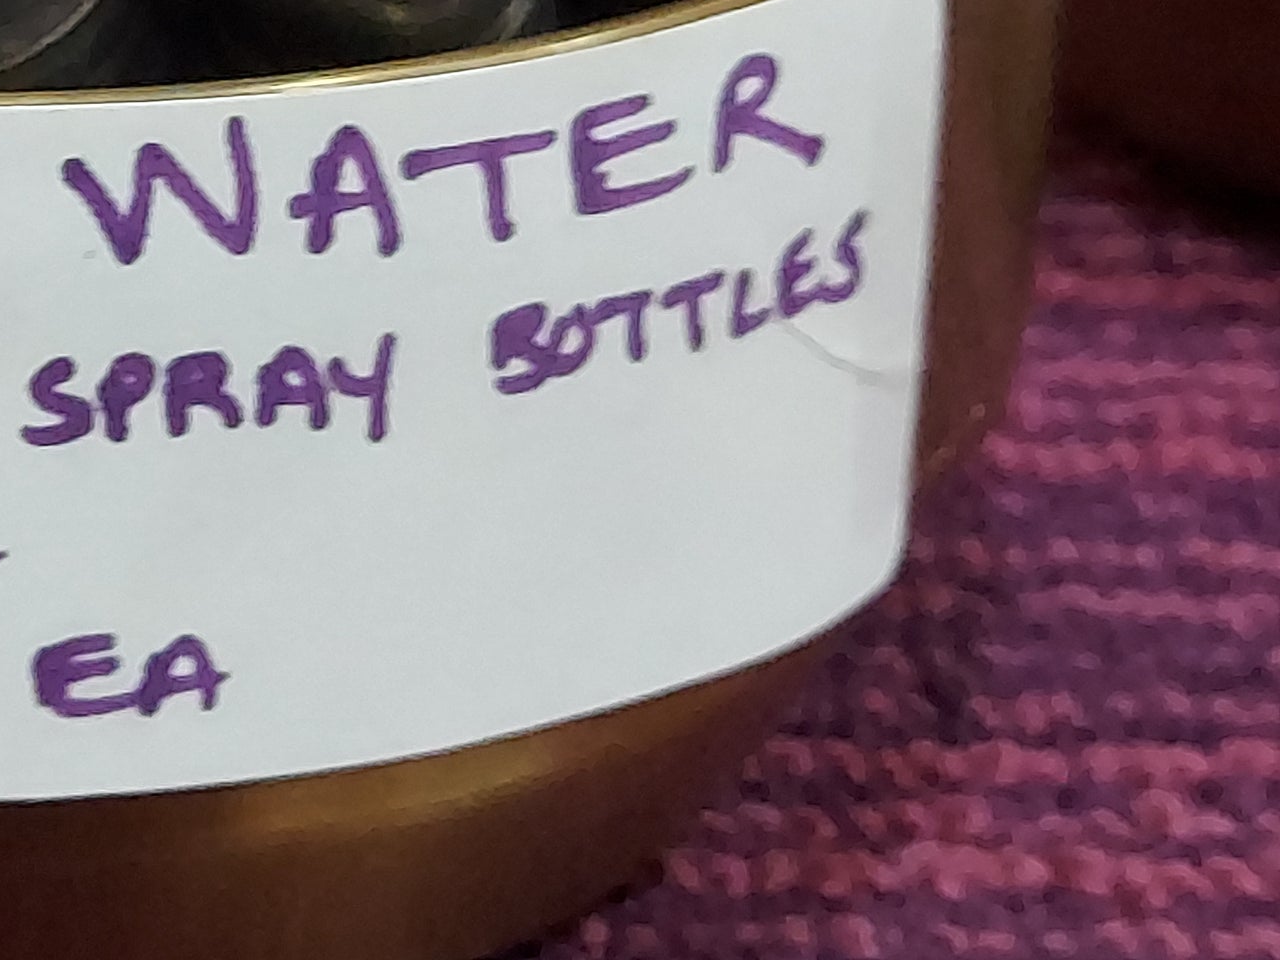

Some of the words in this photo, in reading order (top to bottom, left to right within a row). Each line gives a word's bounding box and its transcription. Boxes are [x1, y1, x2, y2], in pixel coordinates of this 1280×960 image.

[61, 52, 826, 266] WATER
[20, 330, 398, 447] SPRAY
[490, 207, 873, 395] BOTTLES
[31, 632, 230, 718] EA
